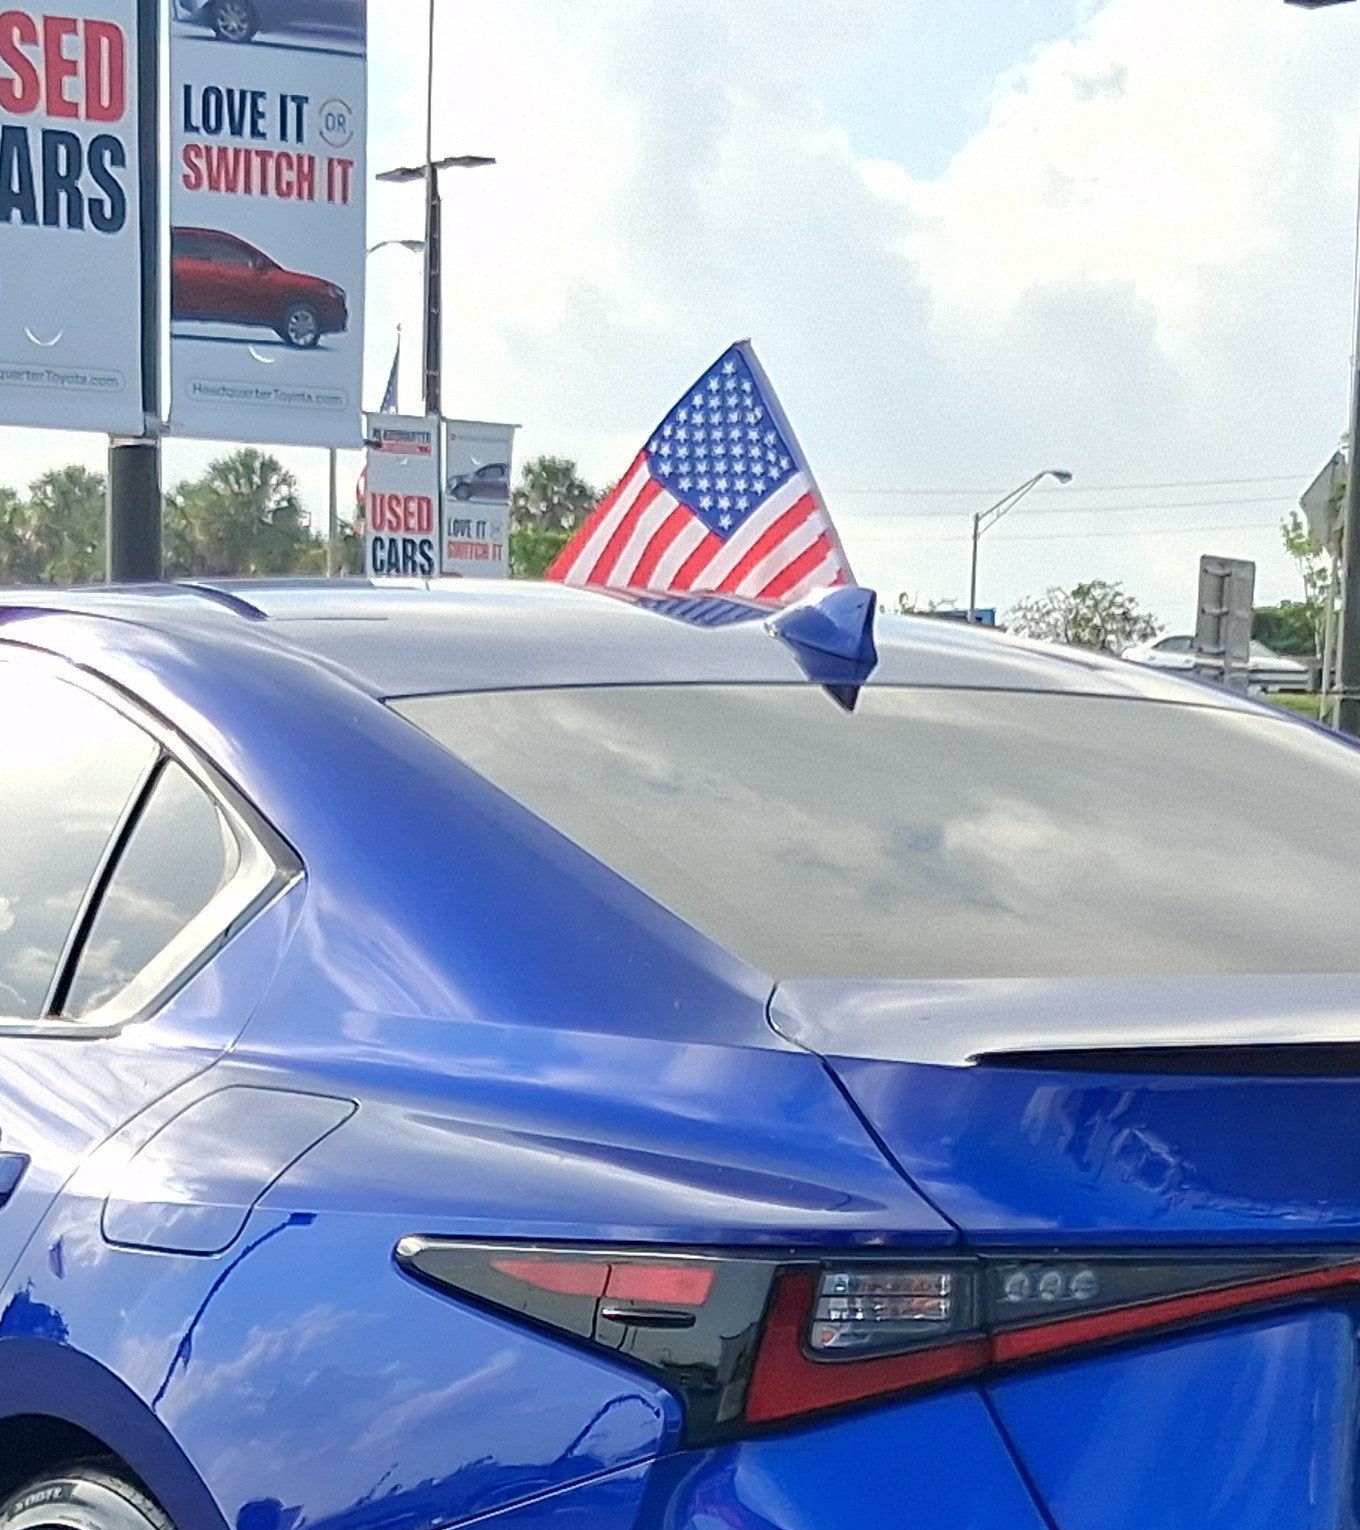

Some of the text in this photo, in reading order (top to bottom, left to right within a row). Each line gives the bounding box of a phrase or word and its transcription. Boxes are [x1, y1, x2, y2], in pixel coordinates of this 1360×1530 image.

[183, 84, 347, 144] LOVE IT OR
[181, 143, 354, 205] SWITCH IT
[370, 492, 434, 534] USED
[371, 535, 435, 576] CARS
